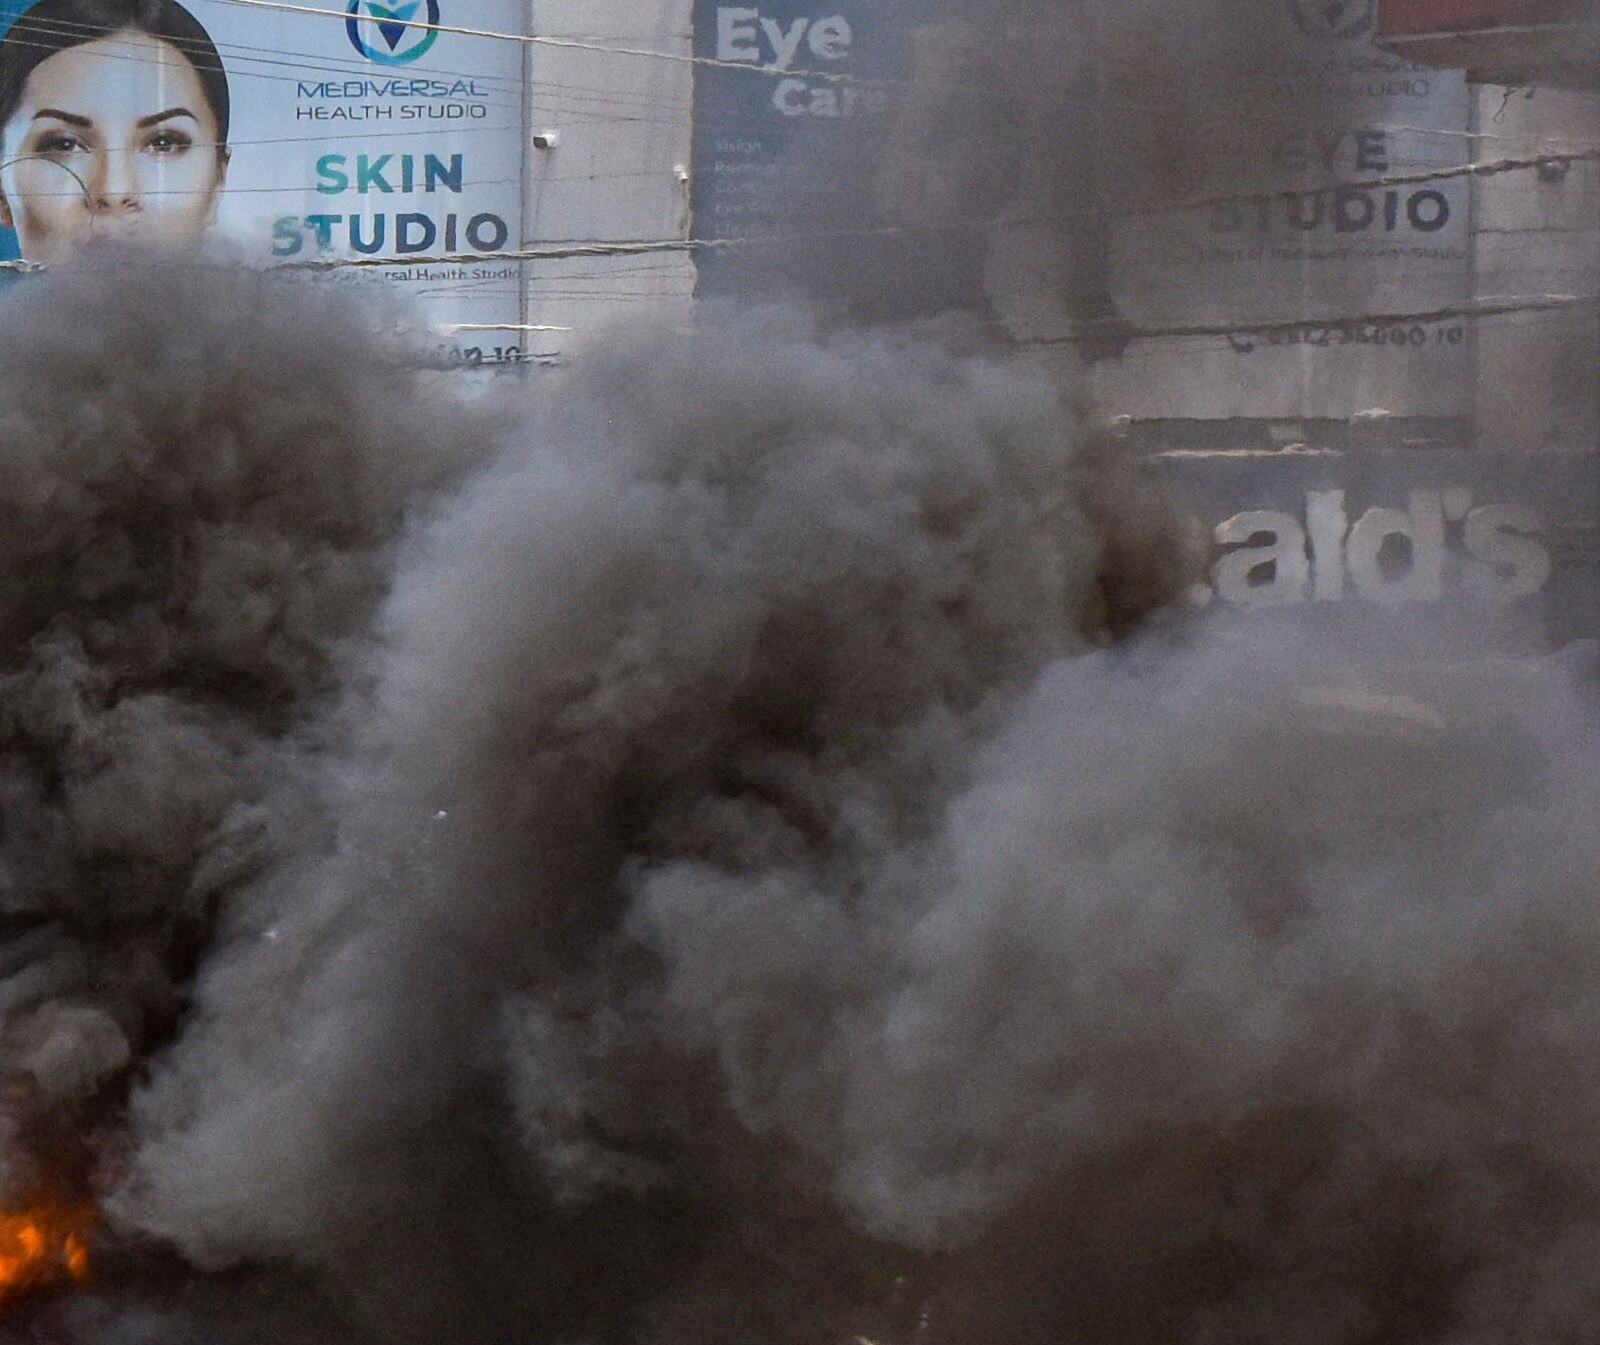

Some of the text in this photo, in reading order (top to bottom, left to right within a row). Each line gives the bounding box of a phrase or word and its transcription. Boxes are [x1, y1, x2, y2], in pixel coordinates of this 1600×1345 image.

[716, 6, 853, 74] Eye
[297, 79, 489, 98] MEDIVERSAL
[296, 104, 487, 120] HEALTH STUDIO
[314, 154, 464, 195] SKIN
[271, 211, 509, 257] STUDIO
[1200, 483, 1553, 604] ald's
